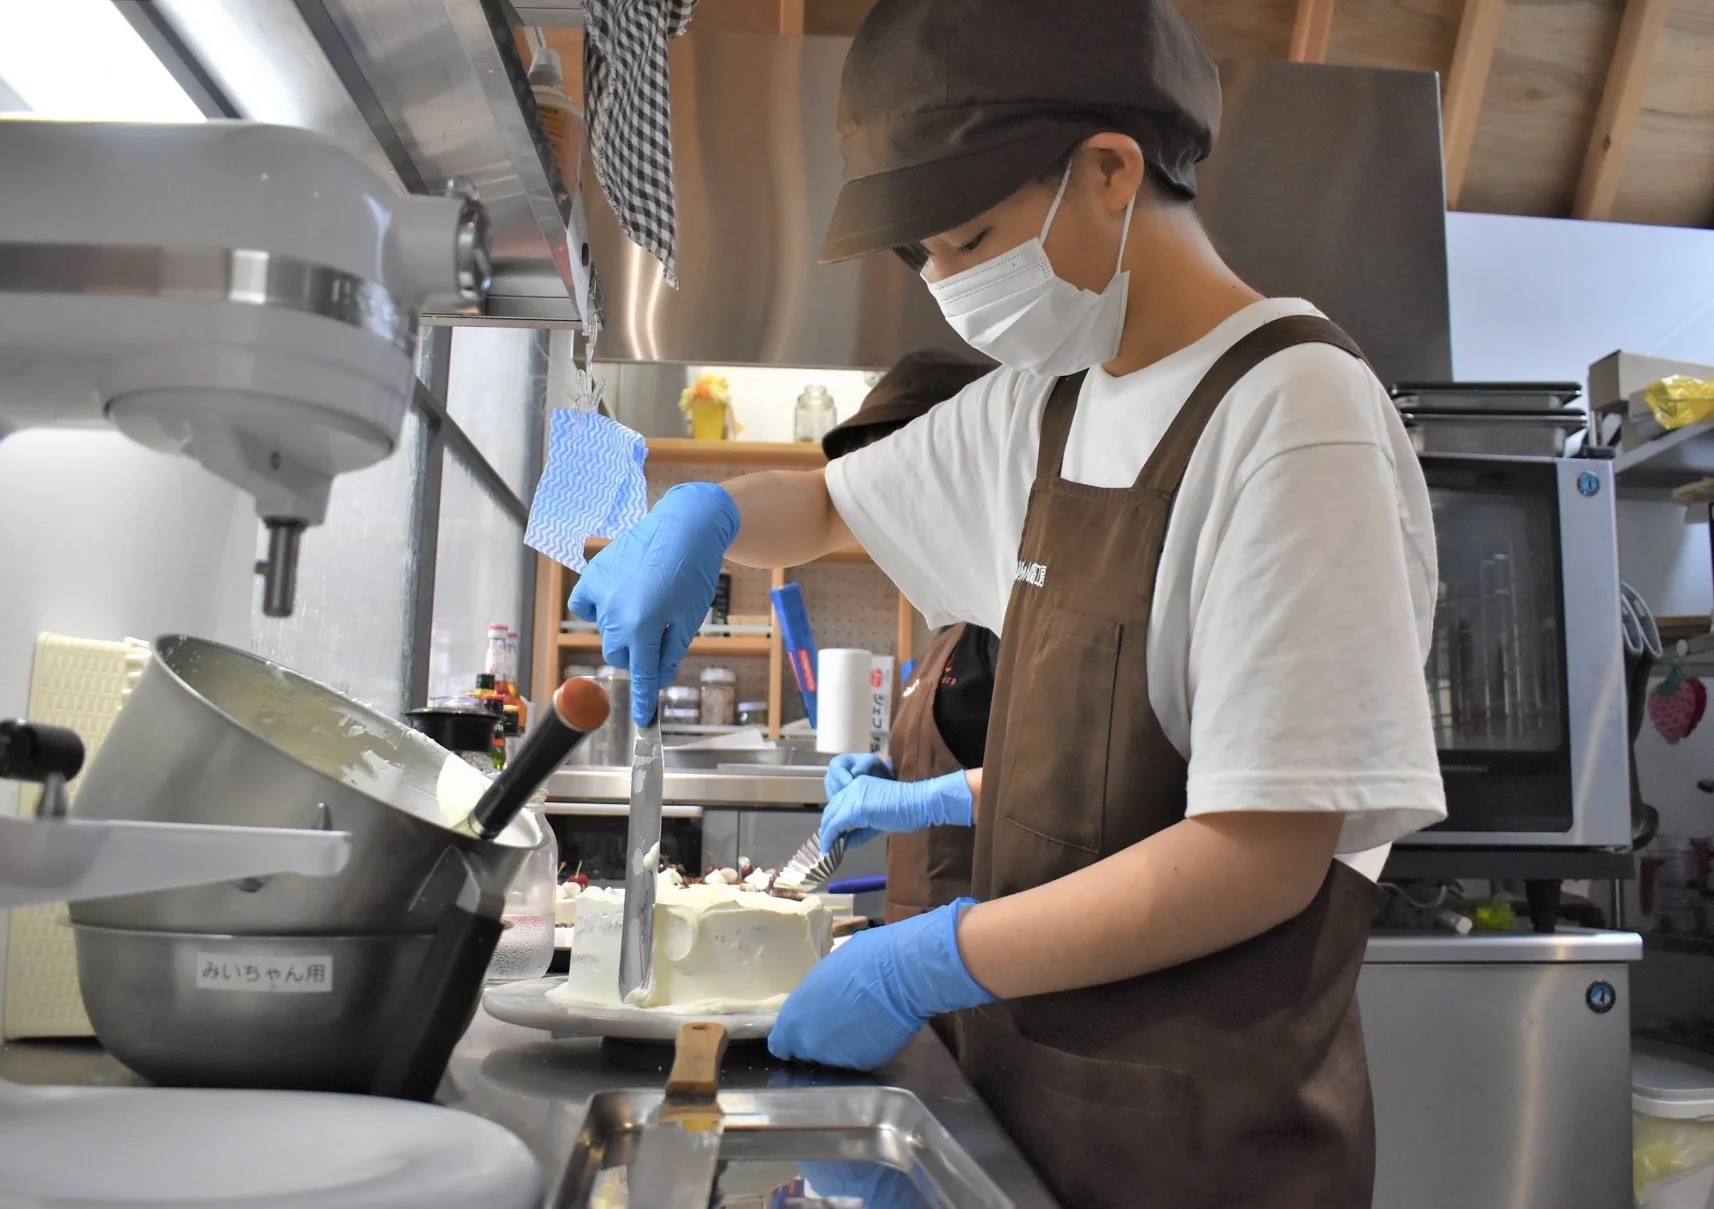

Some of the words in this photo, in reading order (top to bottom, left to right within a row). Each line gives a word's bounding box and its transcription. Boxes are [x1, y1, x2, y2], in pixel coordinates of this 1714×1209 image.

[201, 961, 326, 983] みいちゃん用
